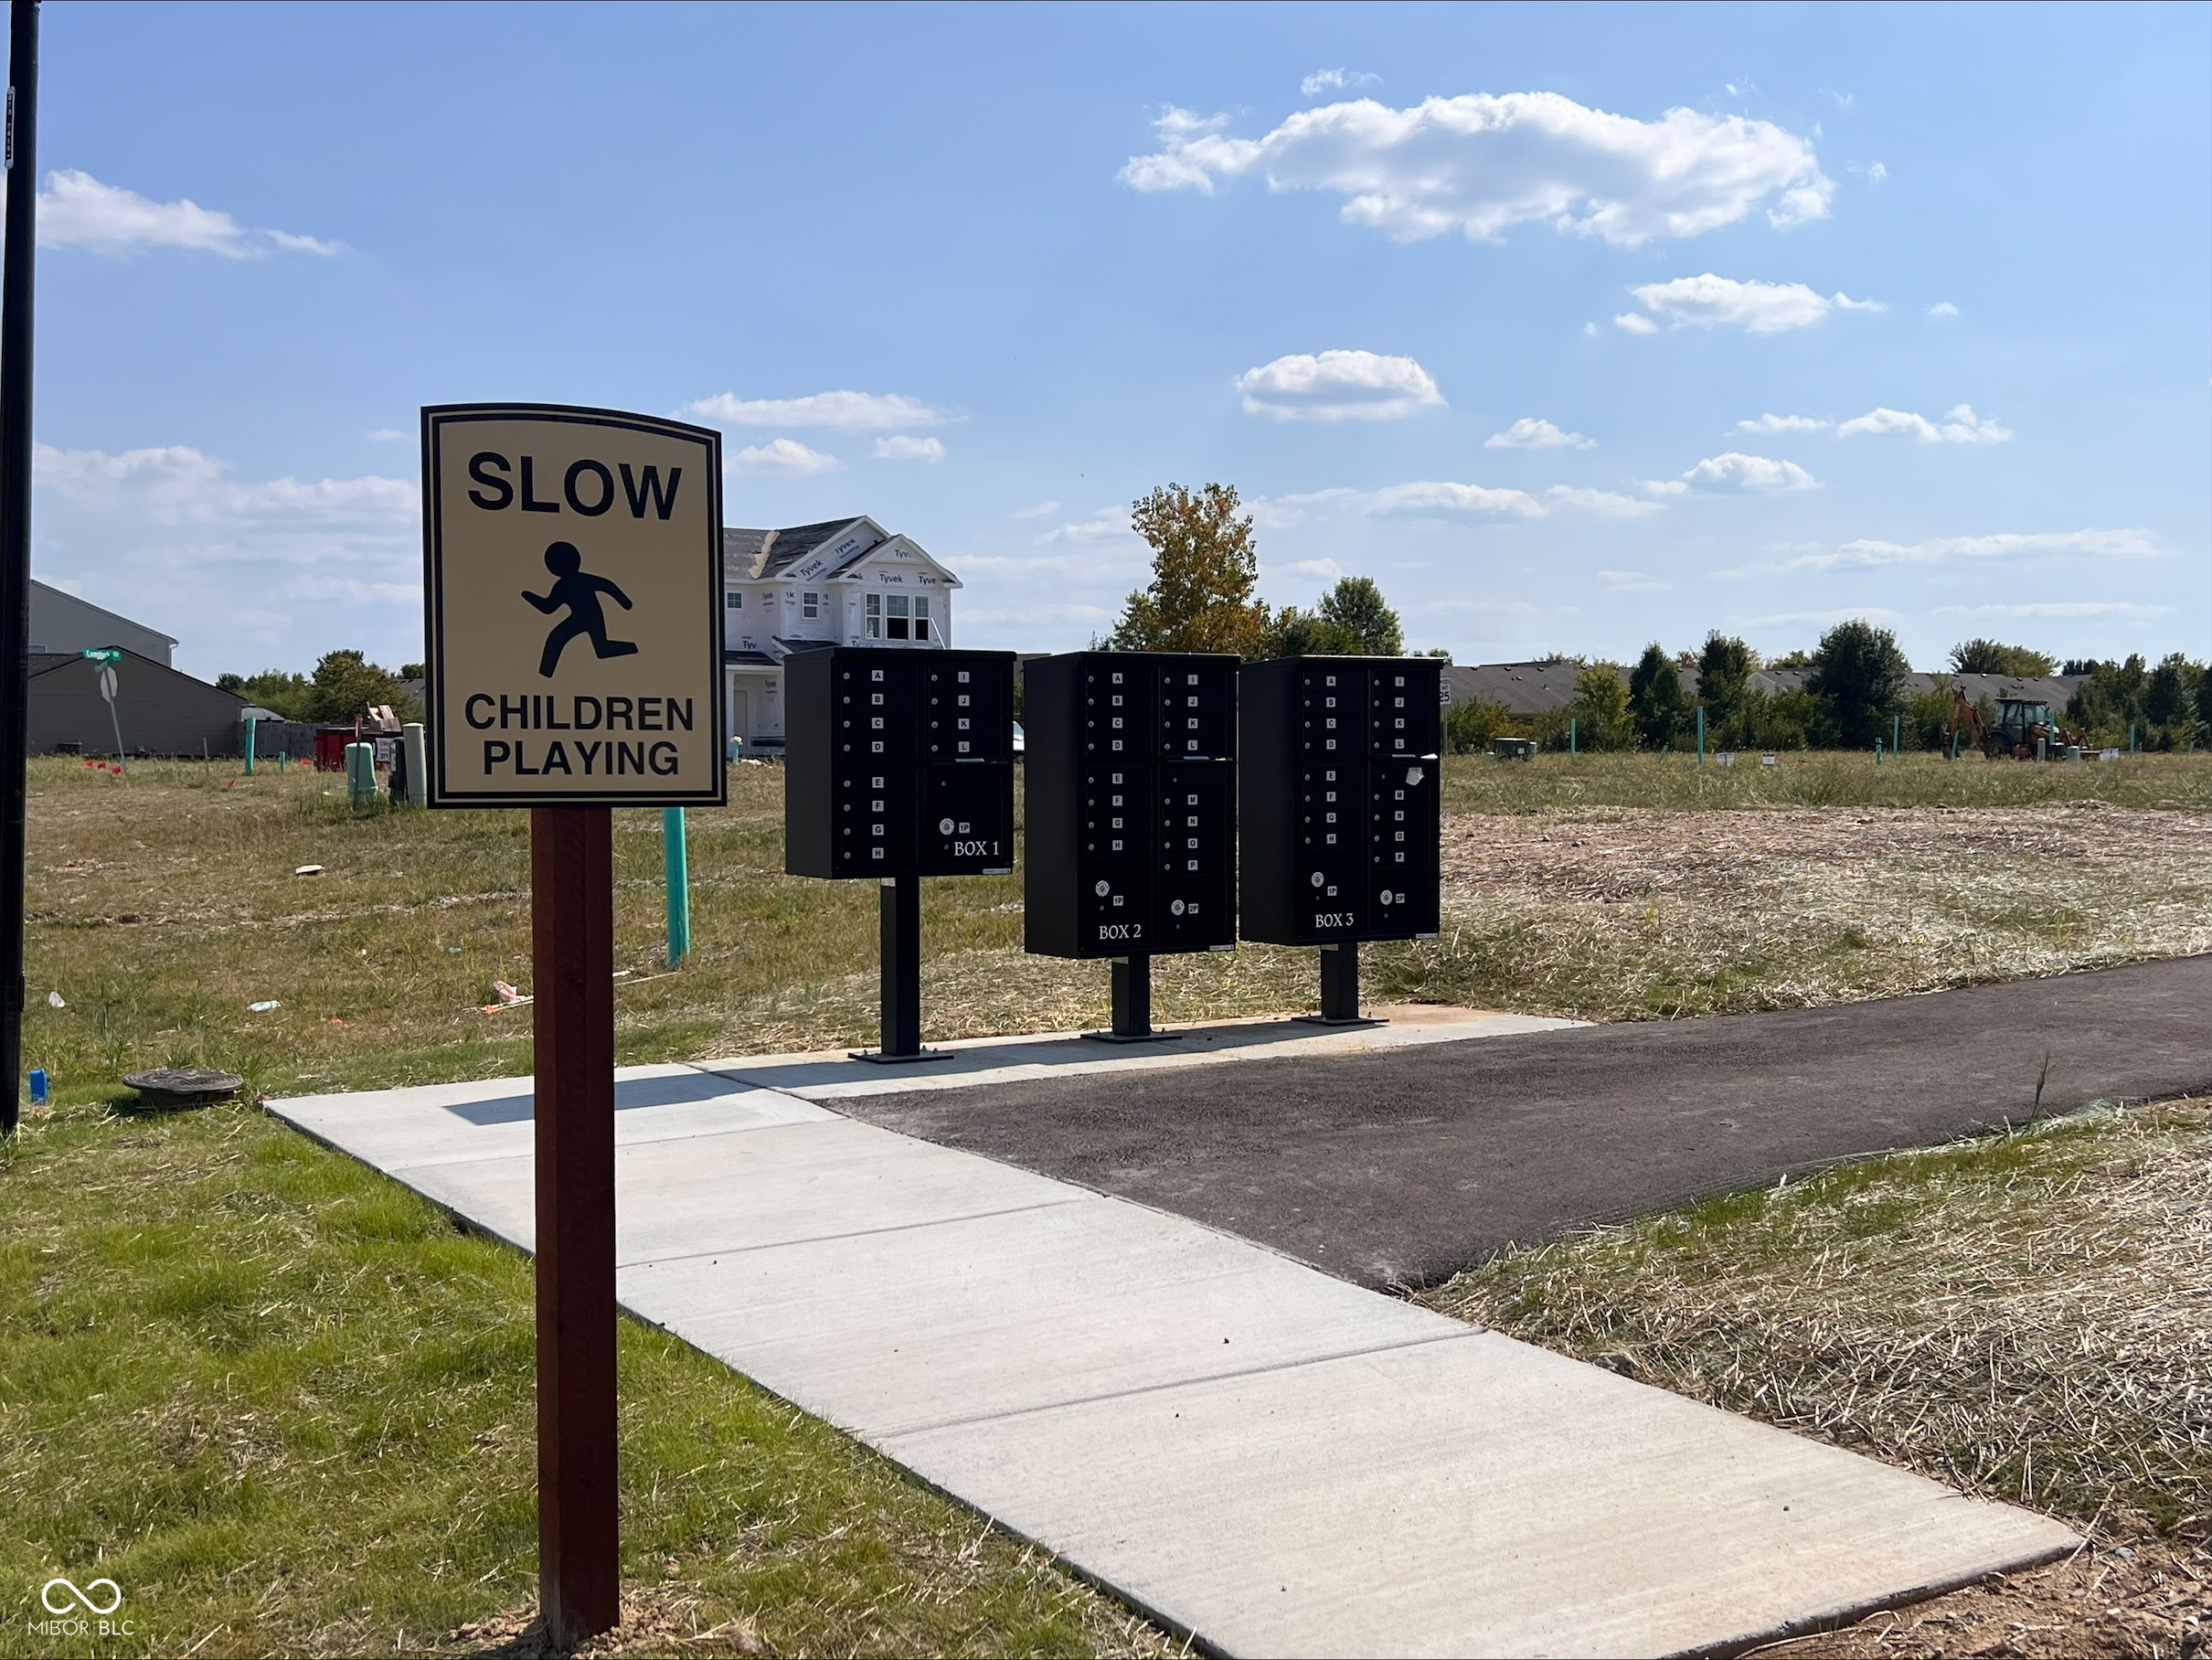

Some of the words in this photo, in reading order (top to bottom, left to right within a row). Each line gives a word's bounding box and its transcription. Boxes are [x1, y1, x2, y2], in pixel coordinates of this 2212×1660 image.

[467, 452, 682, 520] SLOW
[835, 537, 856, 554] Tyvek
[895, 549, 913, 559] Tyv
[800, 559, 824, 577] Tyvek
[879, 573, 903, 584] Tyvek
[918, 576, 937, 586] Tyve
[742, 641, 757, 651] Tyv
[1440, 691, 1450, 702] 25
[465, 693, 693, 731] CHILDREN
[484, 740, 679, 776] PLAYING
[960, 824, 970, 832] 1P
[954, 841, 987, 856] BOX
[993, 841, 999, 855] 1
[1315, 913, 1344, 928] BOX
[1345, 912, 1354, 926] 3
[1099, 924, 1130, 940] BOX
[1133, 923, 1142, 938] 2
